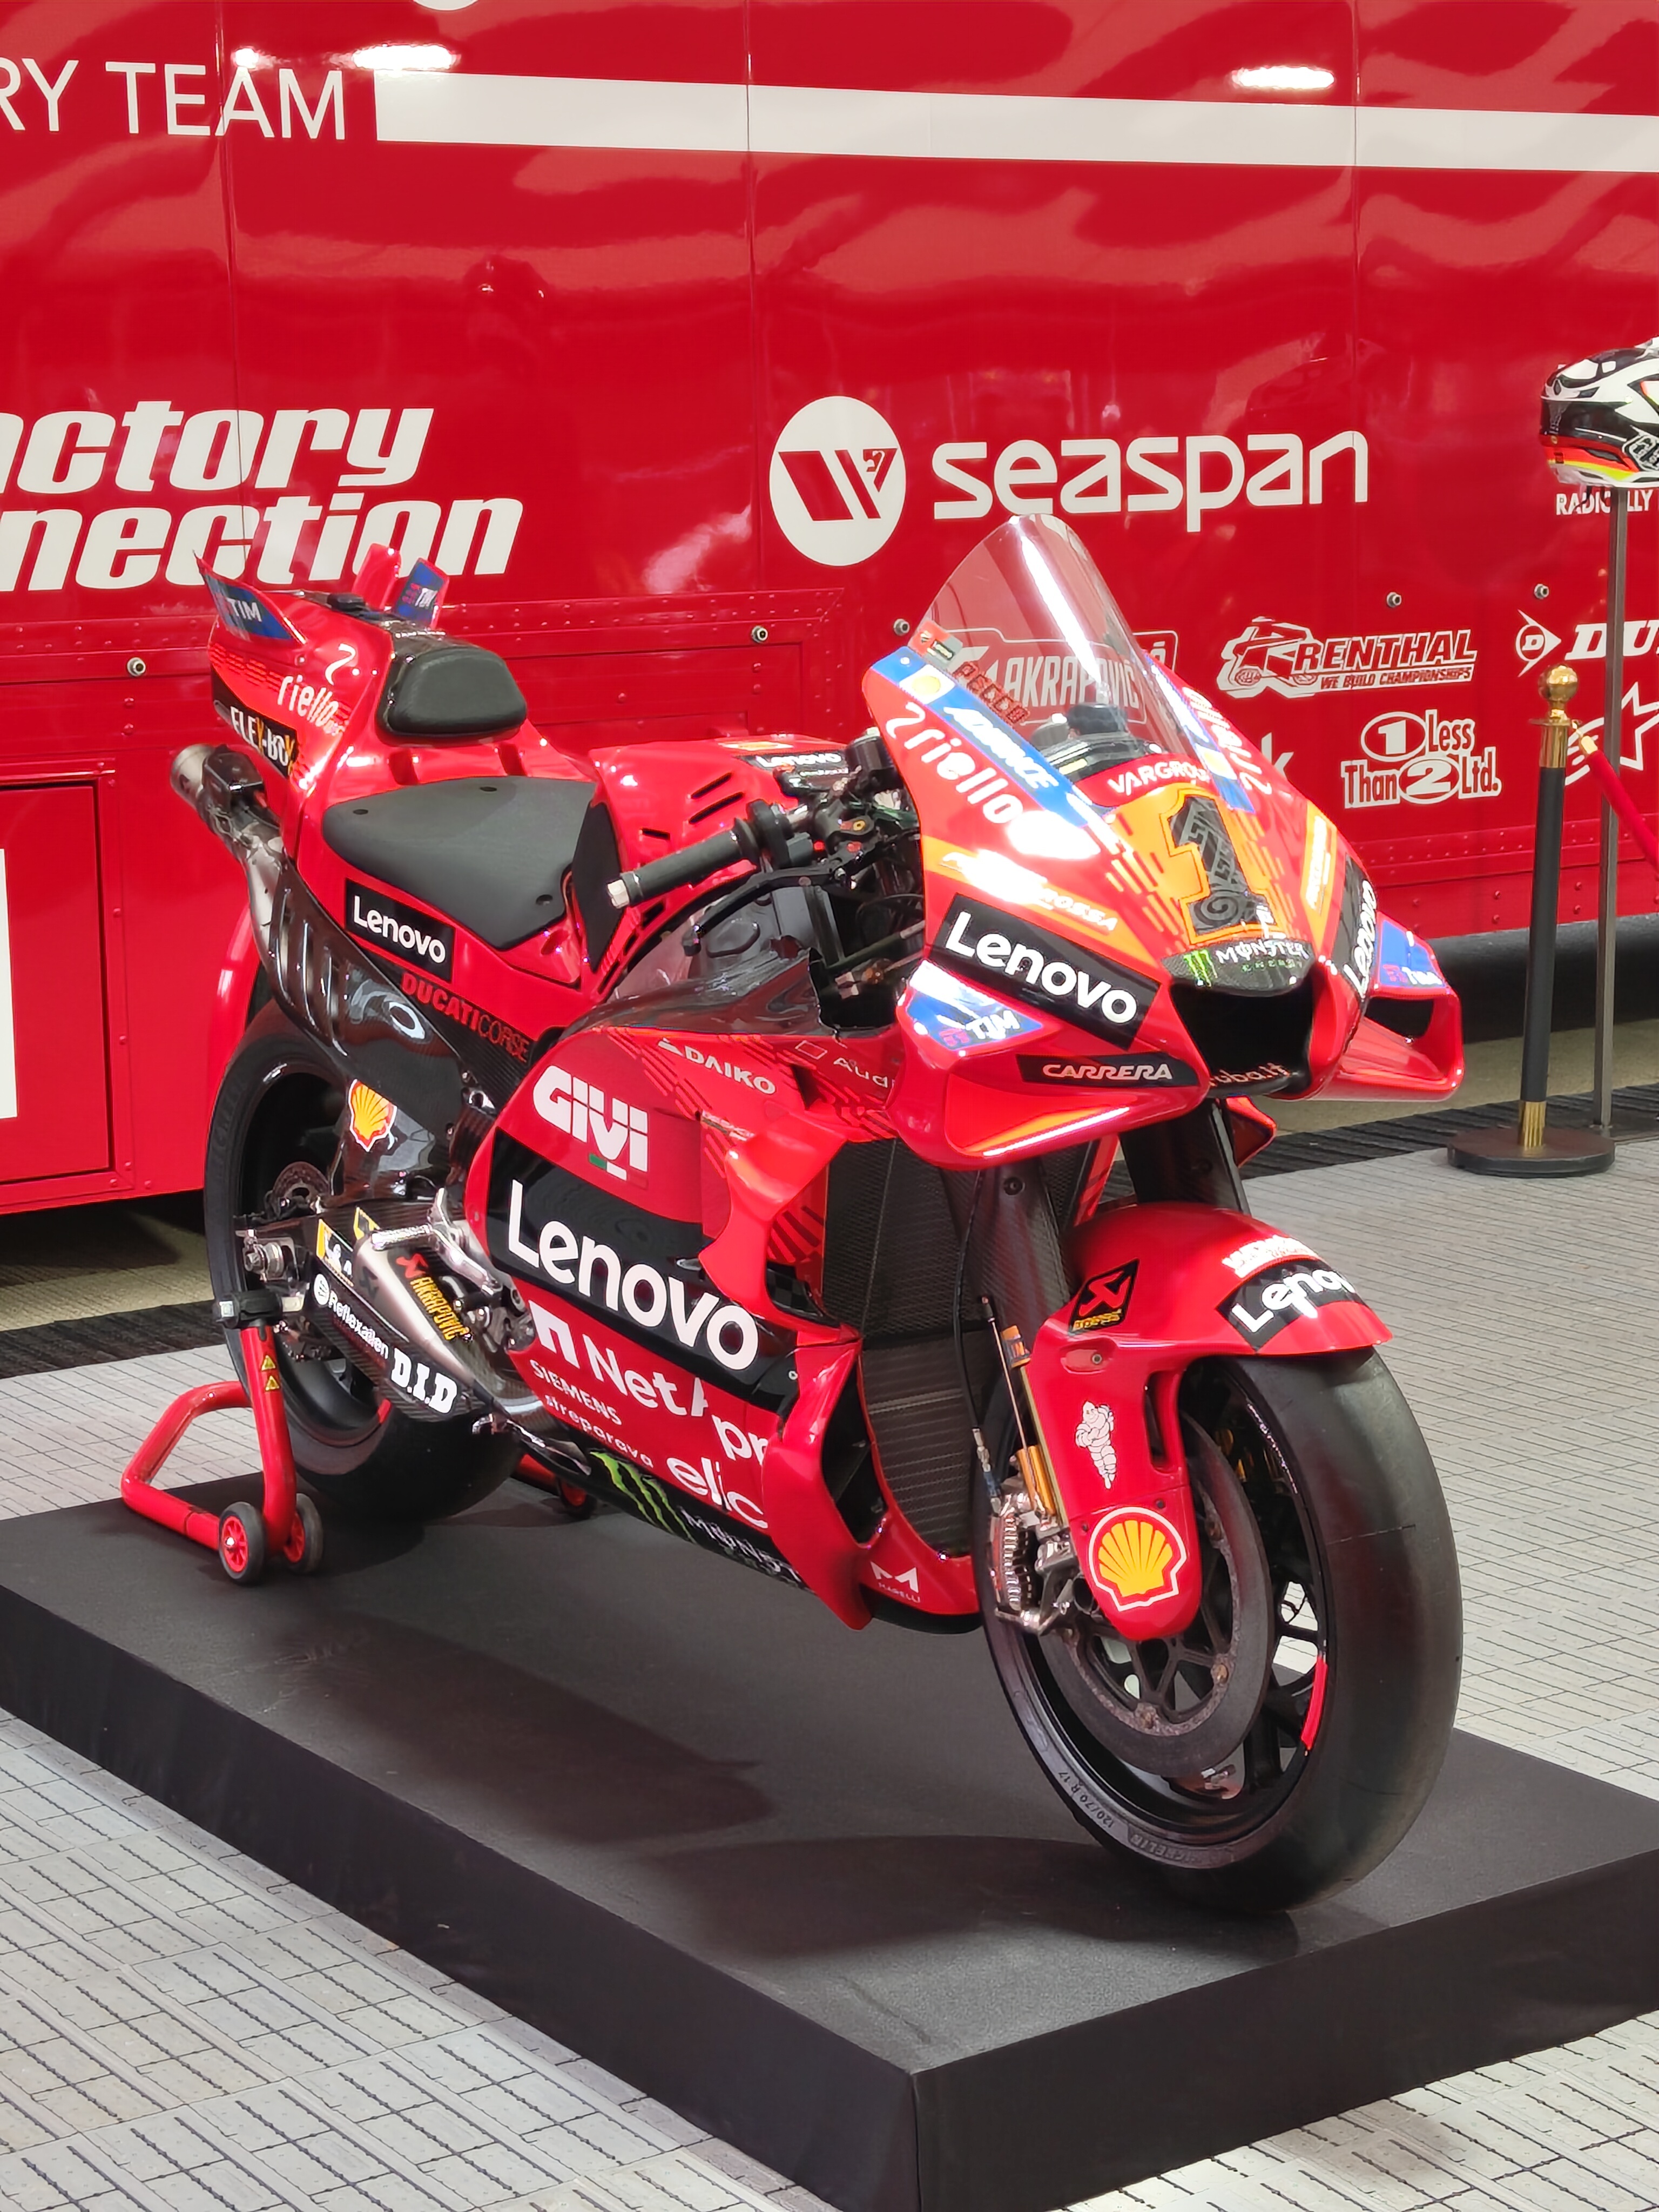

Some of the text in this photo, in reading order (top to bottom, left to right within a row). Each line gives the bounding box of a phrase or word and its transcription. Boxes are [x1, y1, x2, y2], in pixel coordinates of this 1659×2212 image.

[105, 62, 345, 140] TEAM
[934, 430, 1368, 532] seaspan
[1556, 489, 1653, 515] RADICLLY
[225, 596, 262, 622] TIM
[1291, 629, 1478, 673] RENTHAL
[1321, 667, 1473, 690] WE BUILD CHAMPIONSHIPS
[278, 675, 339, 727] riello
[1378, 713, 1473, 755] 1 Less
[903, 728, 1023, 824] riello
[1345, 751, 1499, 805] Than 2 Ltd.
[354, 895, 446, 964] Lenovo
[945, 911, 1138, 1024] Lenovo
[1042, 1063, 1173, 1080] CARRERA
[508, 1179, 759, 1371] Lenovo
[391, 1347, 458, 1414] D.I.D
[529, 1359, 622, 1426] SIEMENS
